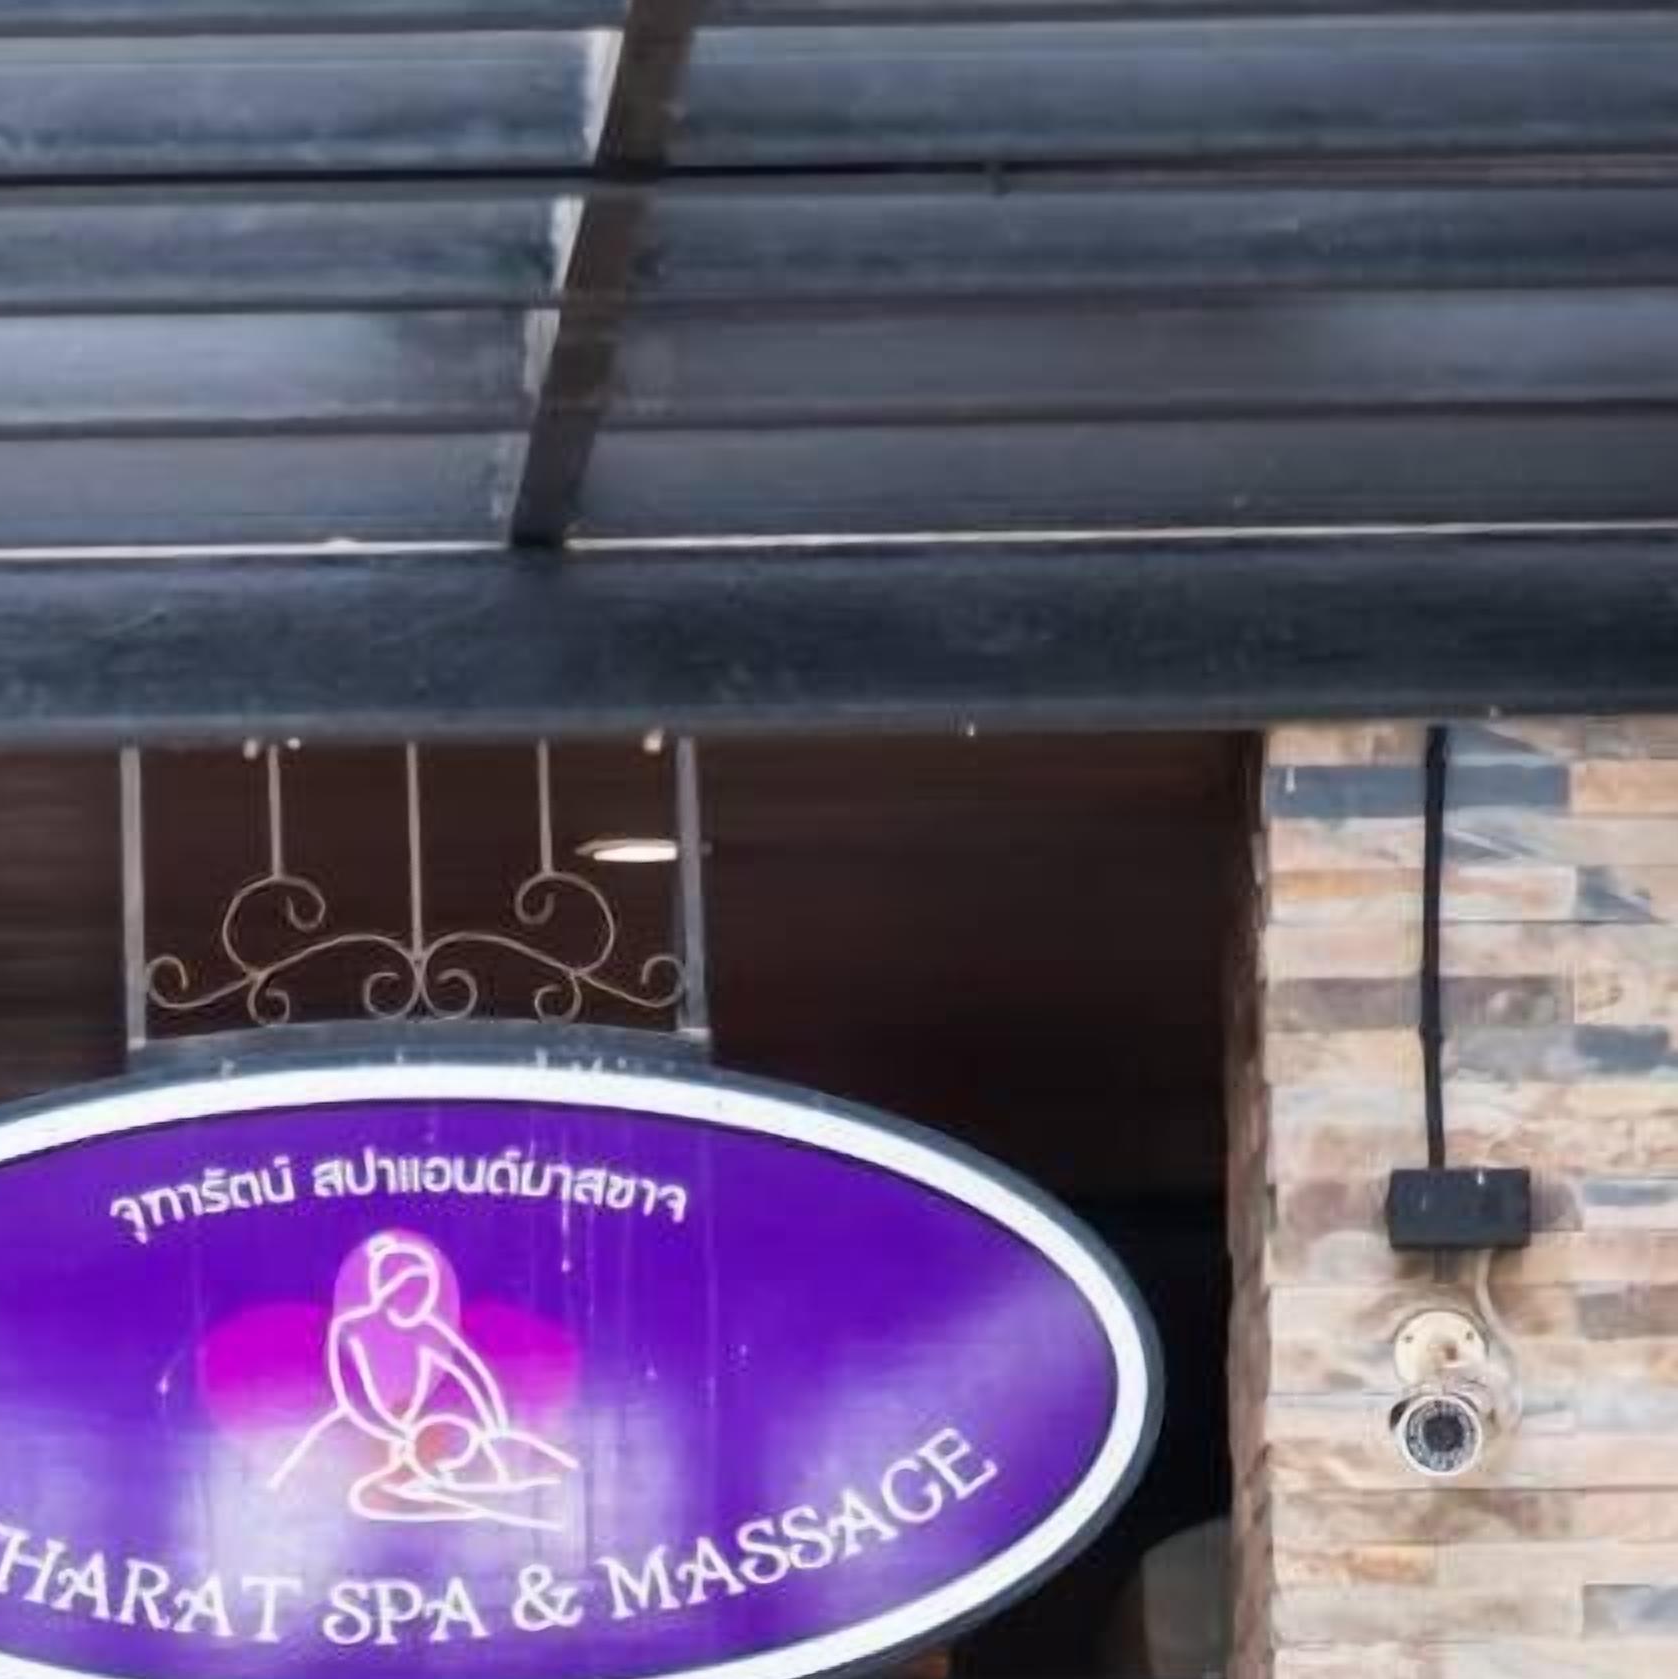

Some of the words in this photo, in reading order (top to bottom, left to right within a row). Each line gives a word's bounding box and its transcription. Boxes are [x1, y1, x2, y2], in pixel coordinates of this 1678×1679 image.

[323, 1576, 490, 1645] SPA
[512, 1563, 584, 1632] &
[596, 1427, 999, 1620] MASSAGE
